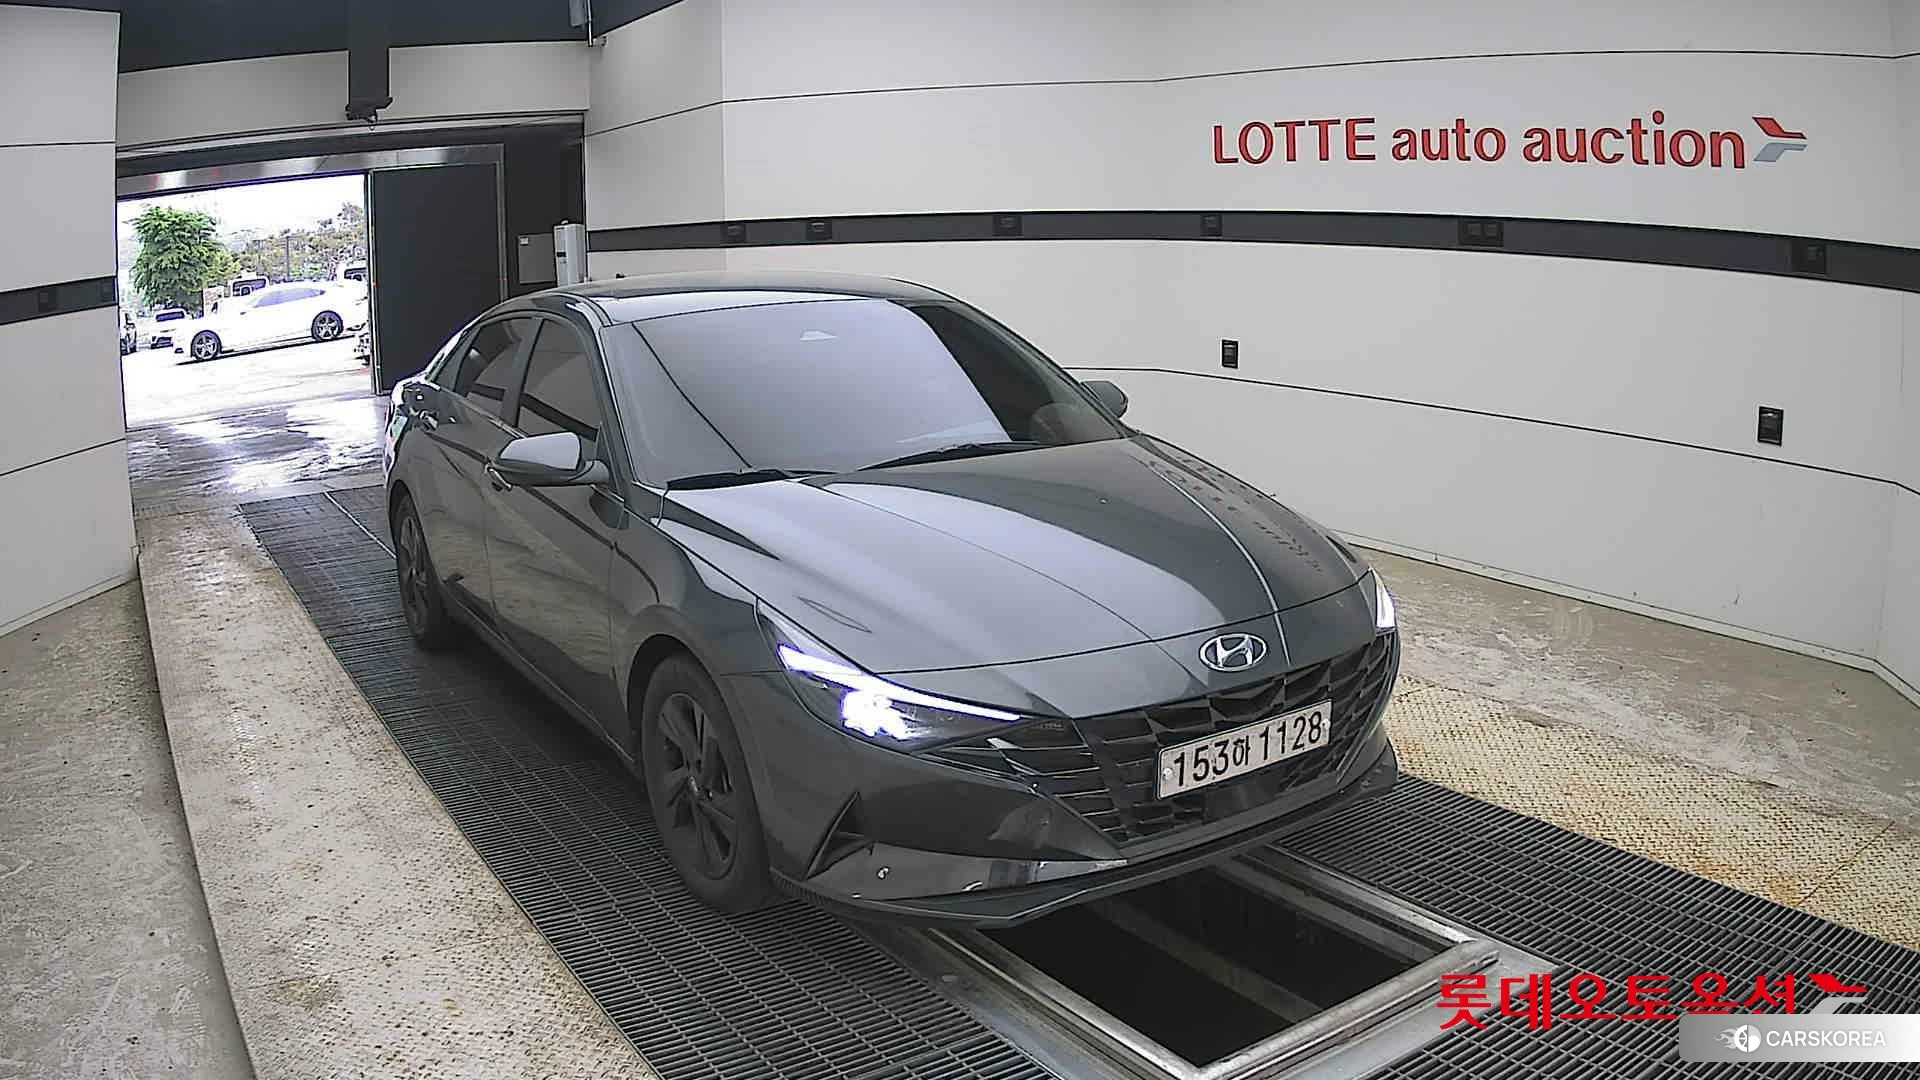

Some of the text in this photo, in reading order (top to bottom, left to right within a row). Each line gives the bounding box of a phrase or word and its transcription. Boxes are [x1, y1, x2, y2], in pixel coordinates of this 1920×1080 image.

[1213, 110, 1746, 169] LOTTE auto auction
[1173, 711, 1322, 787] 153하 1128
